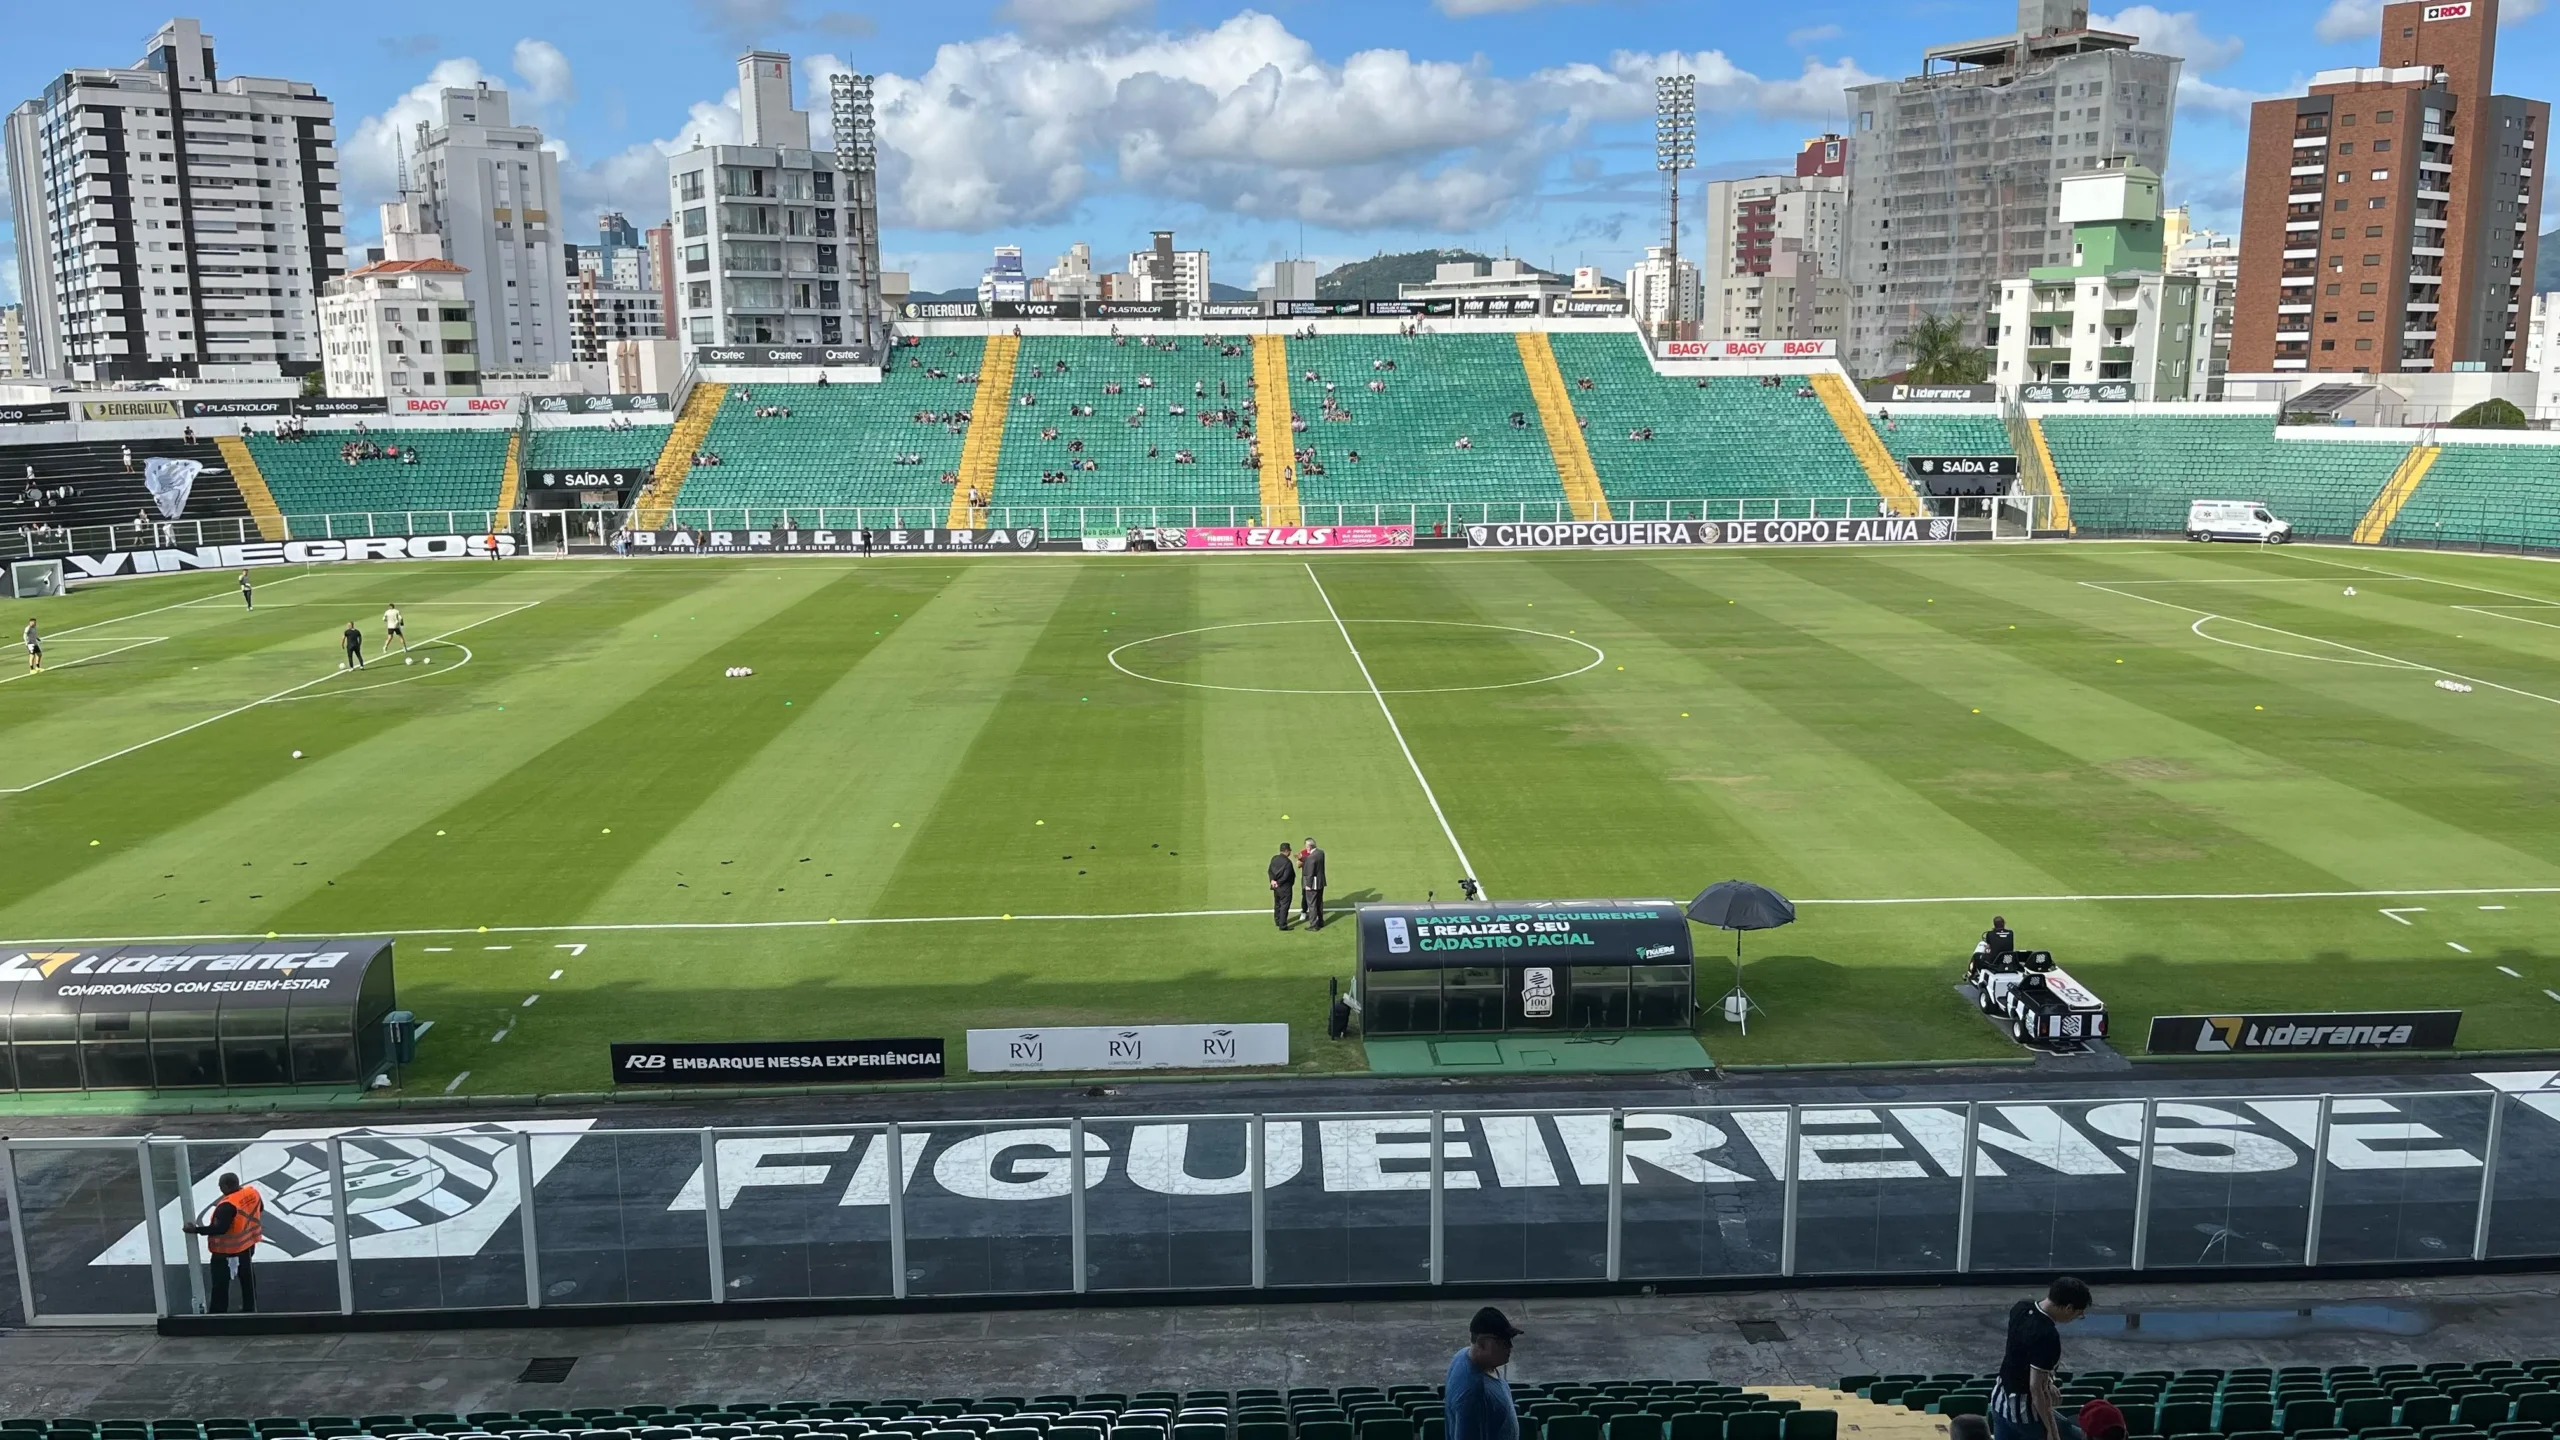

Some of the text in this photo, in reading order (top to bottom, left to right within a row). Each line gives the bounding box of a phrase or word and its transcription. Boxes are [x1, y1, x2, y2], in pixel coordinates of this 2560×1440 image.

[2440, 5, 2467, 18] RDO
[921, 303, 978, 317] ENERGILUZ
[1027, 305, 1058, 315] VOLT
[1568, 302, 1624, 313] Liderança
[1668, 340, 1826, 356] IBAGY IBAGY IBAGY
[1909, 388, 1971, 400] Liderança
[108, 403, 169, 416] ENERGILUZ
[207, 403, 277, 412] PLASTKOLOR
[315, 402, 359, 411] SEJA SÓCIO
[407, 398, 509, 412] IBAGY IBAGY
[1942, 458, 1999, 473] SAÍDA 2
[565, 471, 624, 486] SAÍDA 3
[1248, 527, 1331, 546] ELAS
[1496, 523, 1692, 546] CHOPPGUEIRA
[1727, 522, 1757, 543] DE
[1763, 520, 1829, 542] COPO
[1835, 521, 1850, 541] E
[1854, 520, 1918, 541] ALMA
[64, 535, 516, 580] VINEGROS
[1415, 911, 1659, 925] BAIXE O APP FIGUEIRENSE
[1417, 921, 1571, 937] E REALIZE O SEU
[1419, 933, 1595, 951] CADASTRO FACIAL
[71, 951, 350, 976] Liderança
[57, 977, 331, 997] COMPROMISSO COM SEU BEM-ESTAR
[1530, 998, 1547, 1007] 100
[2245, 1022, 2413, 1048] Liderança
[1009, 1041, 1043, 1061] RVJ
[1109, 1040, 1142, 1060] RVJ
[1202, 1038, 1236, 1058] RVJ
[624, 1050, 941, 1070] RB EMBARQUE NESSA EXPERIÊNCIA!
[666, 1097, 2484, 1212] FIGUEIRENSE
